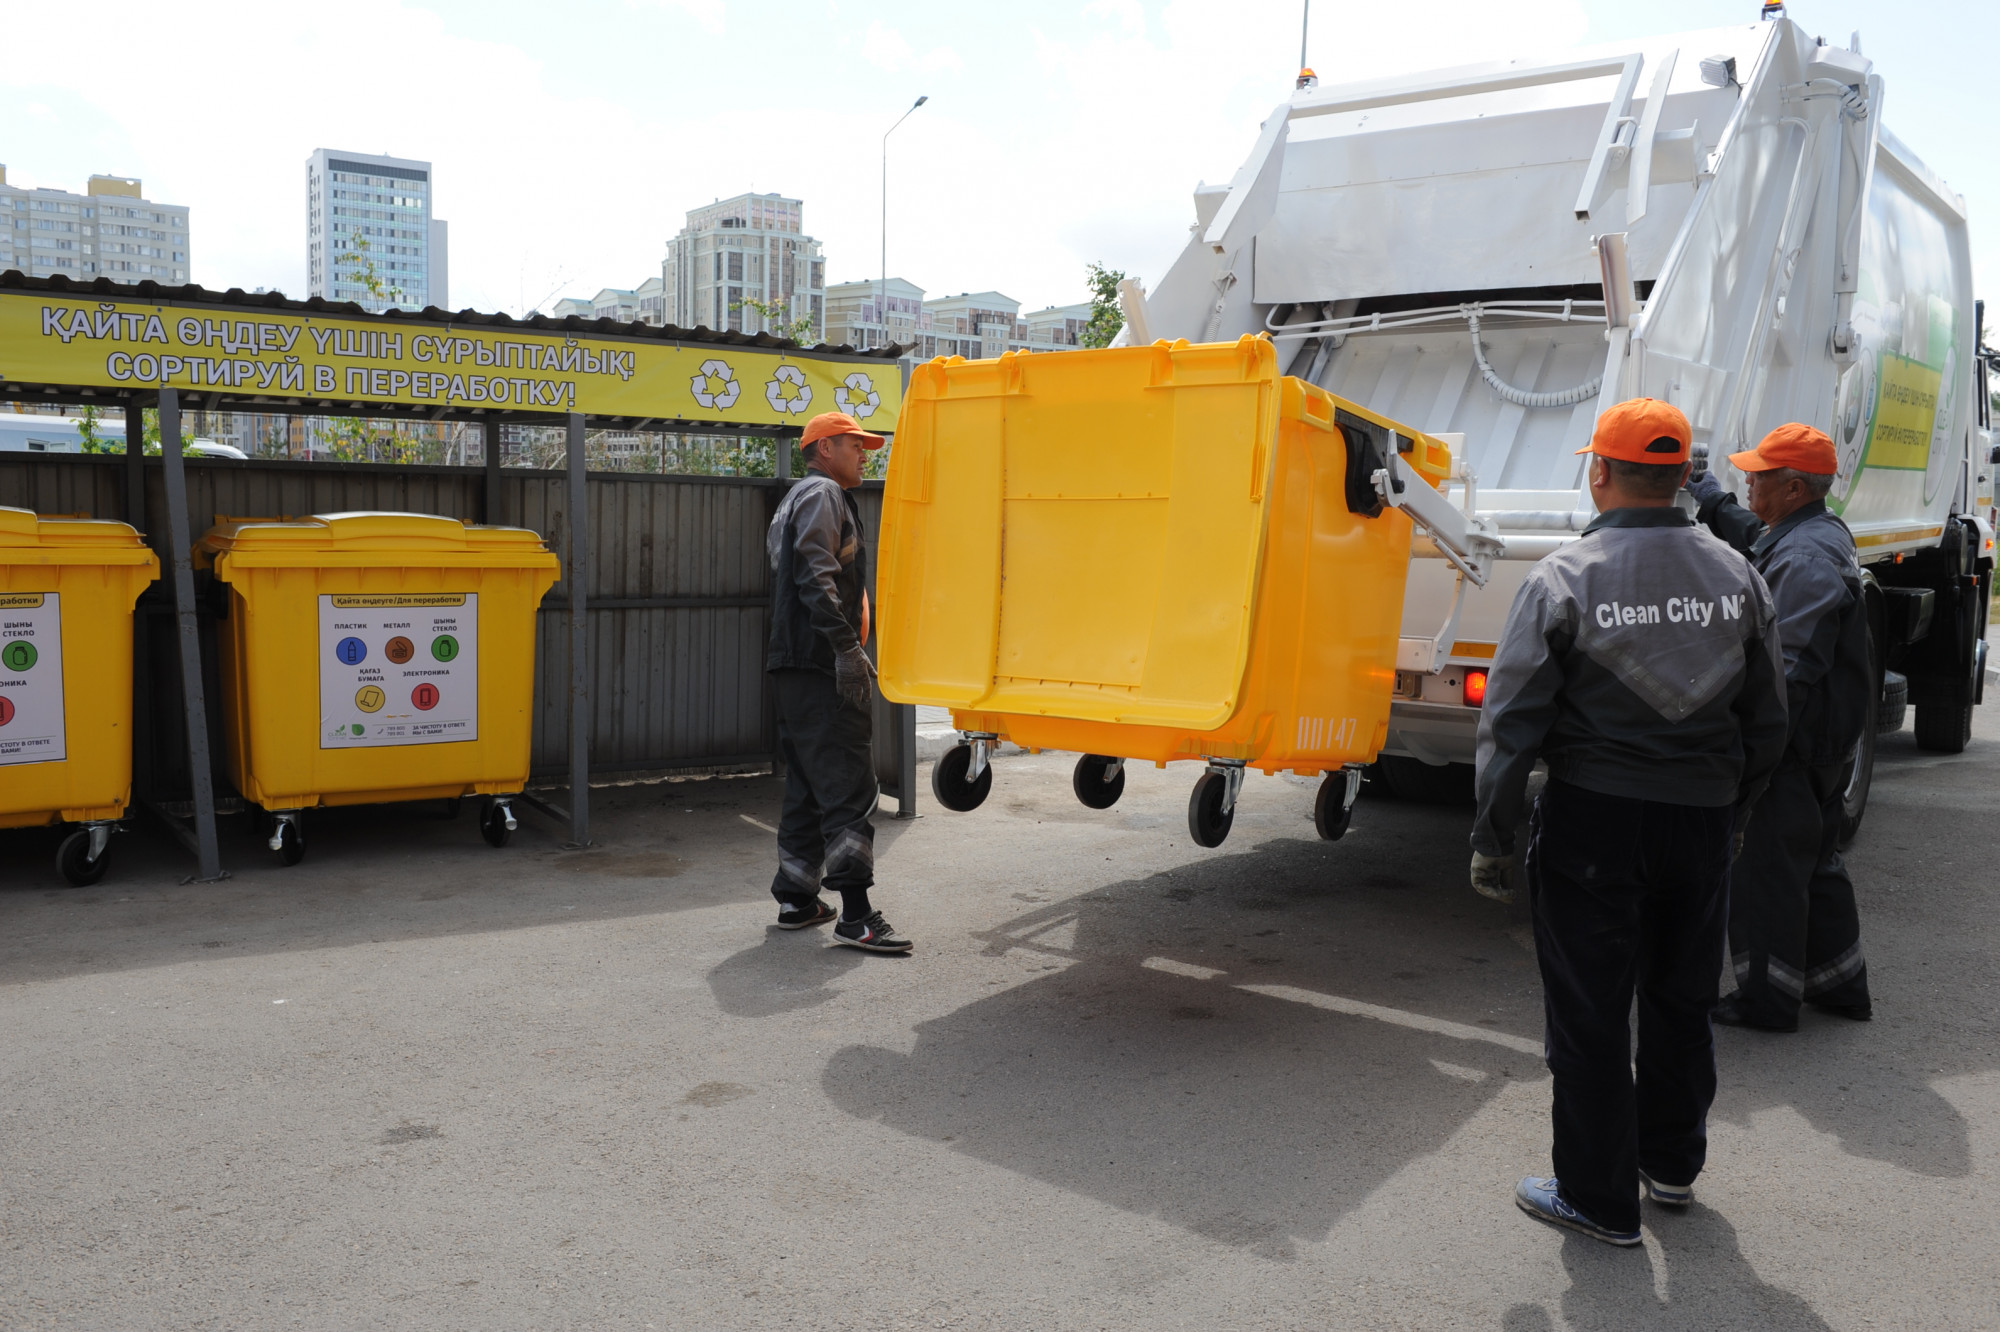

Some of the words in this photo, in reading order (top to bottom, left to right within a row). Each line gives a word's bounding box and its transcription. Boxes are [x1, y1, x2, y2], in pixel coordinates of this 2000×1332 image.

[41, 303, 169, 343] ҚАЙТА
[177, 317, 302, 356] ӨҢДЕУ
[308, 326, 403, 360] ҮШІН
[411, 339, 636, 382] СҰРЫПТАЙЫҚ!
[107, 351, 305, 391] СОРТИРУЙ
[314, 364, 336, 392] В
[345, 366, 576, 407] ПЕРЕРАБОТКУ!
[0, 597, 38, 606] работки
[337, 597, 360, 605] Қайта
[413, 596, 461, 604] переработки
[1595, 601, 1661, 629] Clean
[1666, 596, 1714, 628] City
[4, 621, 33, 629] ШЫНЫ
[2, 629, 35, 637] СТЕКЛО
